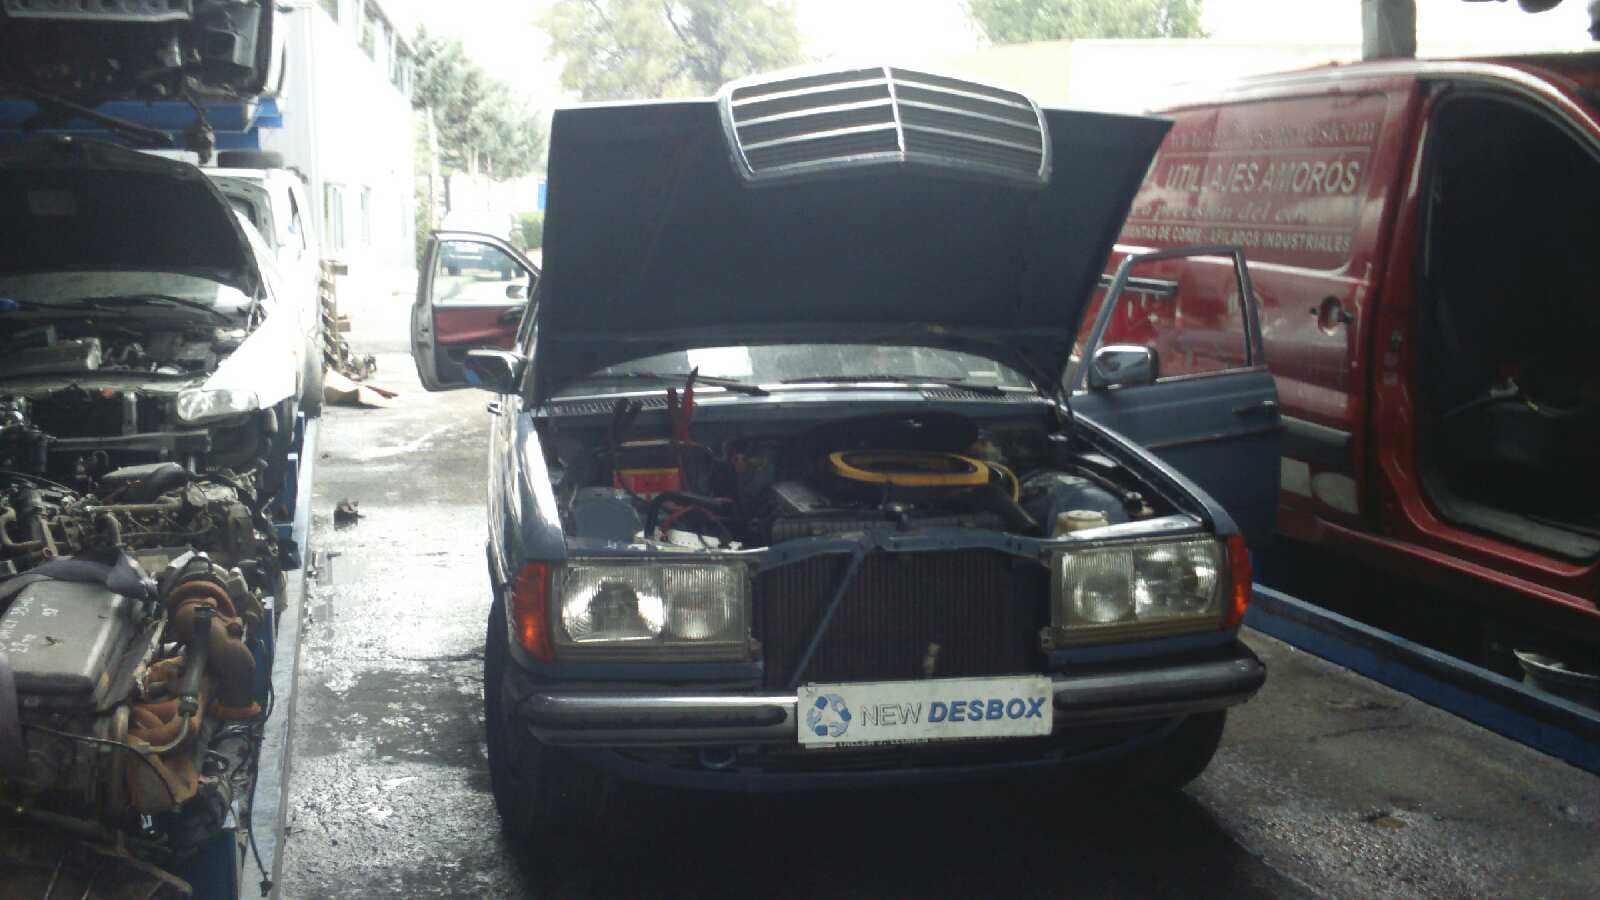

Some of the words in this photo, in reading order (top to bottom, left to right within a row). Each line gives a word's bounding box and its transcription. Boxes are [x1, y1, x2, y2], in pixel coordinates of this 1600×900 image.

[1166, 161, 1258, 194] UTILLAJES
[1257, 154, 1360, 194] AMORÓS
[1262, 231, 1351, 252] INDUSTRIALES
[860, 702, 922, 727] NEW
[928, 697, 1047, 723] DESBOX
